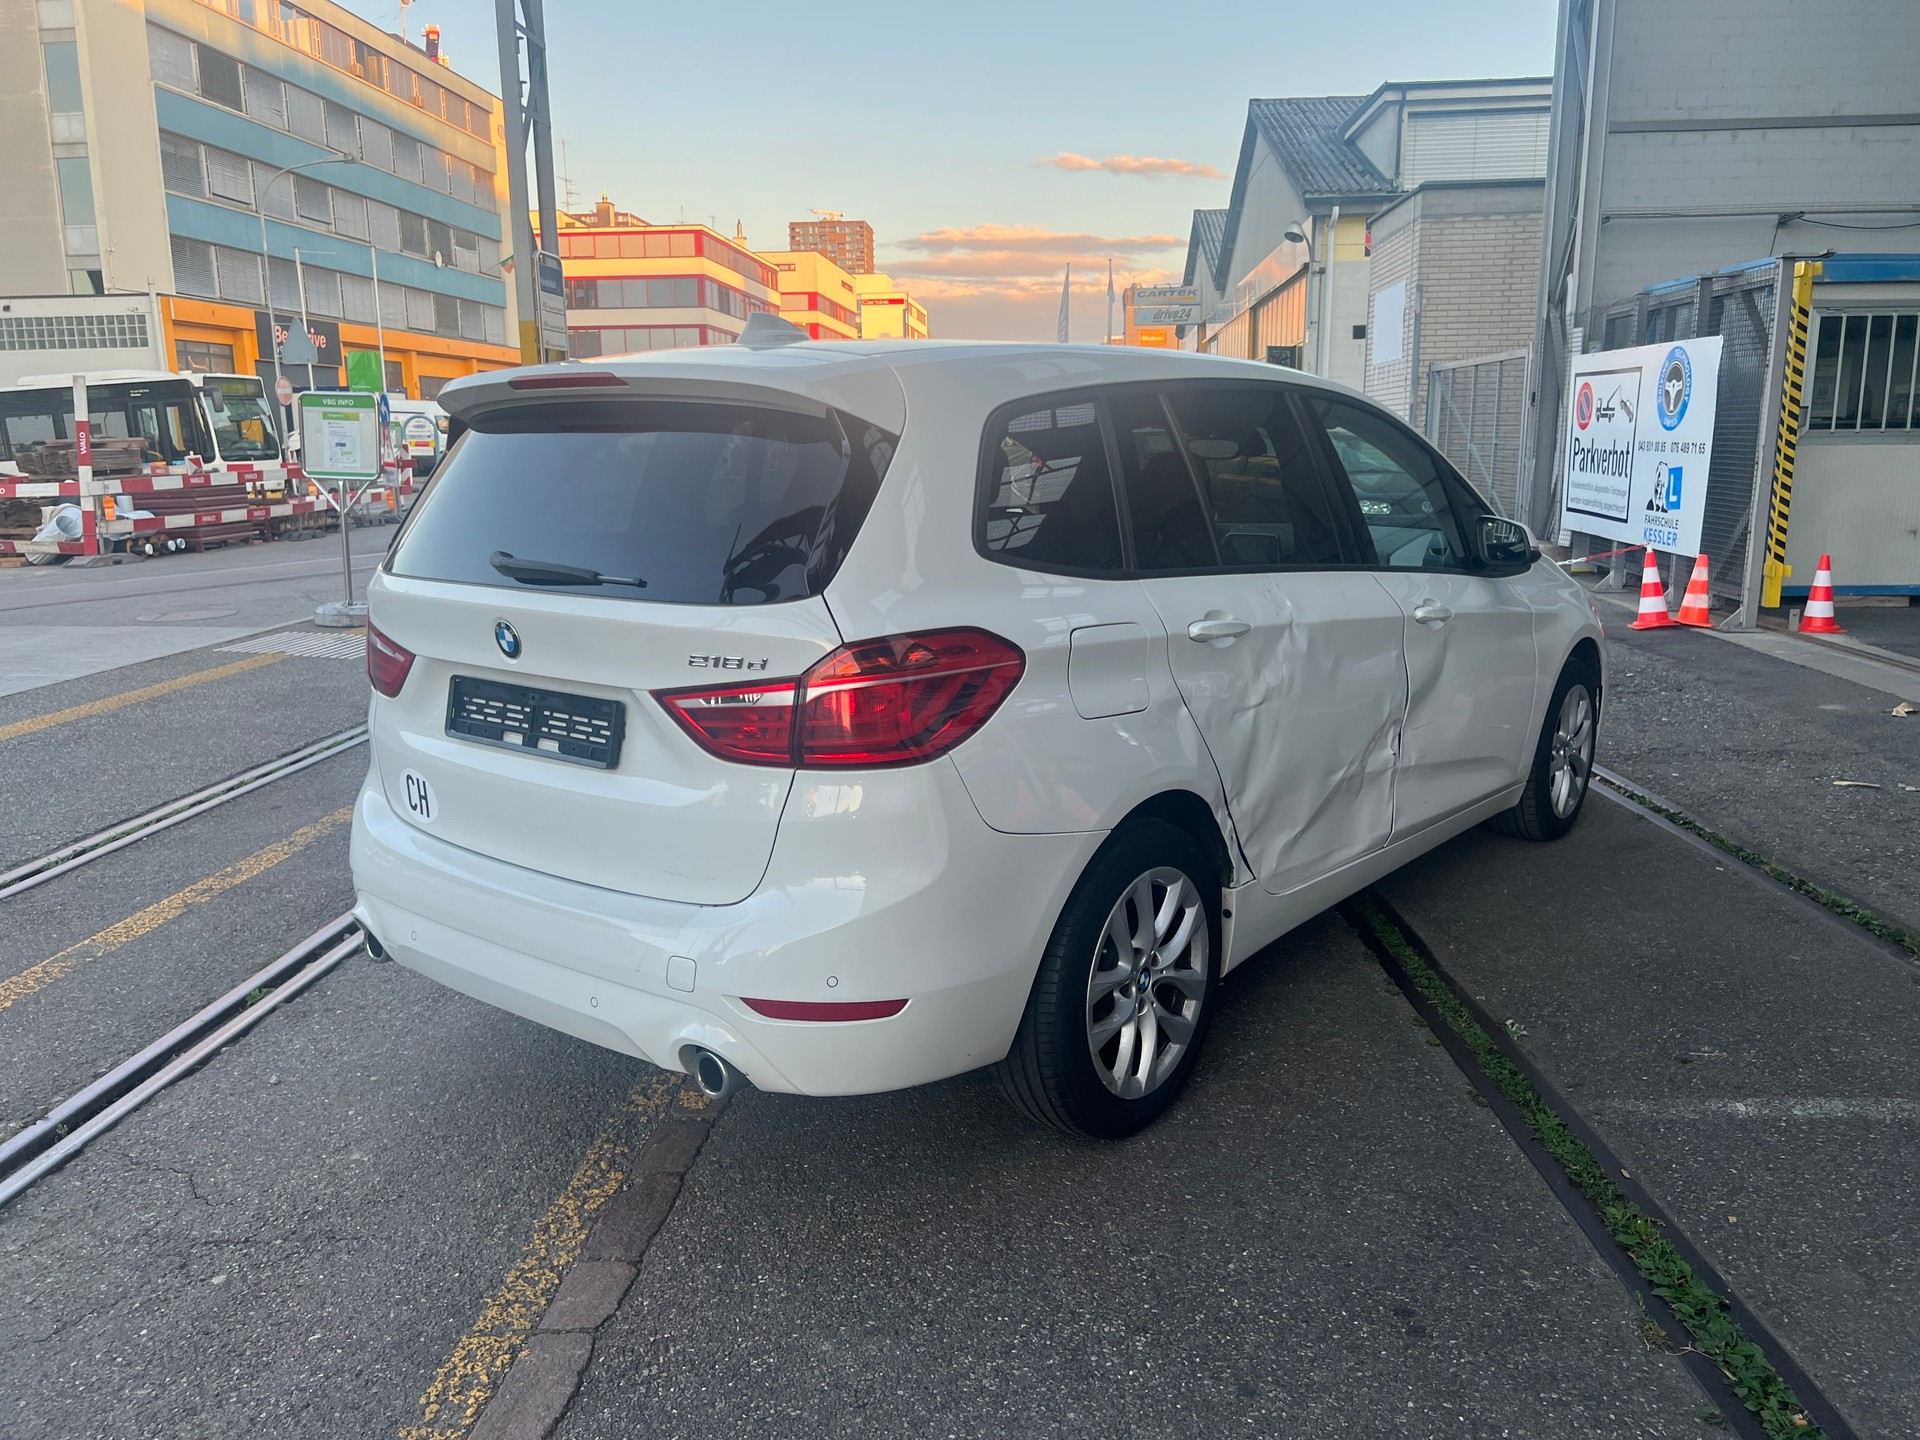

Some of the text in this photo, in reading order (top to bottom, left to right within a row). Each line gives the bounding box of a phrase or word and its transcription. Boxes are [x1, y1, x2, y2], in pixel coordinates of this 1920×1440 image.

[1137, 289, 1198, 298] CARTEK
[1153, 308, 1192, 320] drive24
[1663, 417, 1677, 428] SWISS
[79, 432, 87, 455] WALO
[1691, 442, 1698, 454] 71
[1572, 437, 1629, 478] Parkverbot
[1669, 474, 1677, 502] L
[1644, 514, 1679, 530] FAHRSCHULE
[1643, 528, 1678, 547] KESSLER
[406, 774, 430, 818] CH
